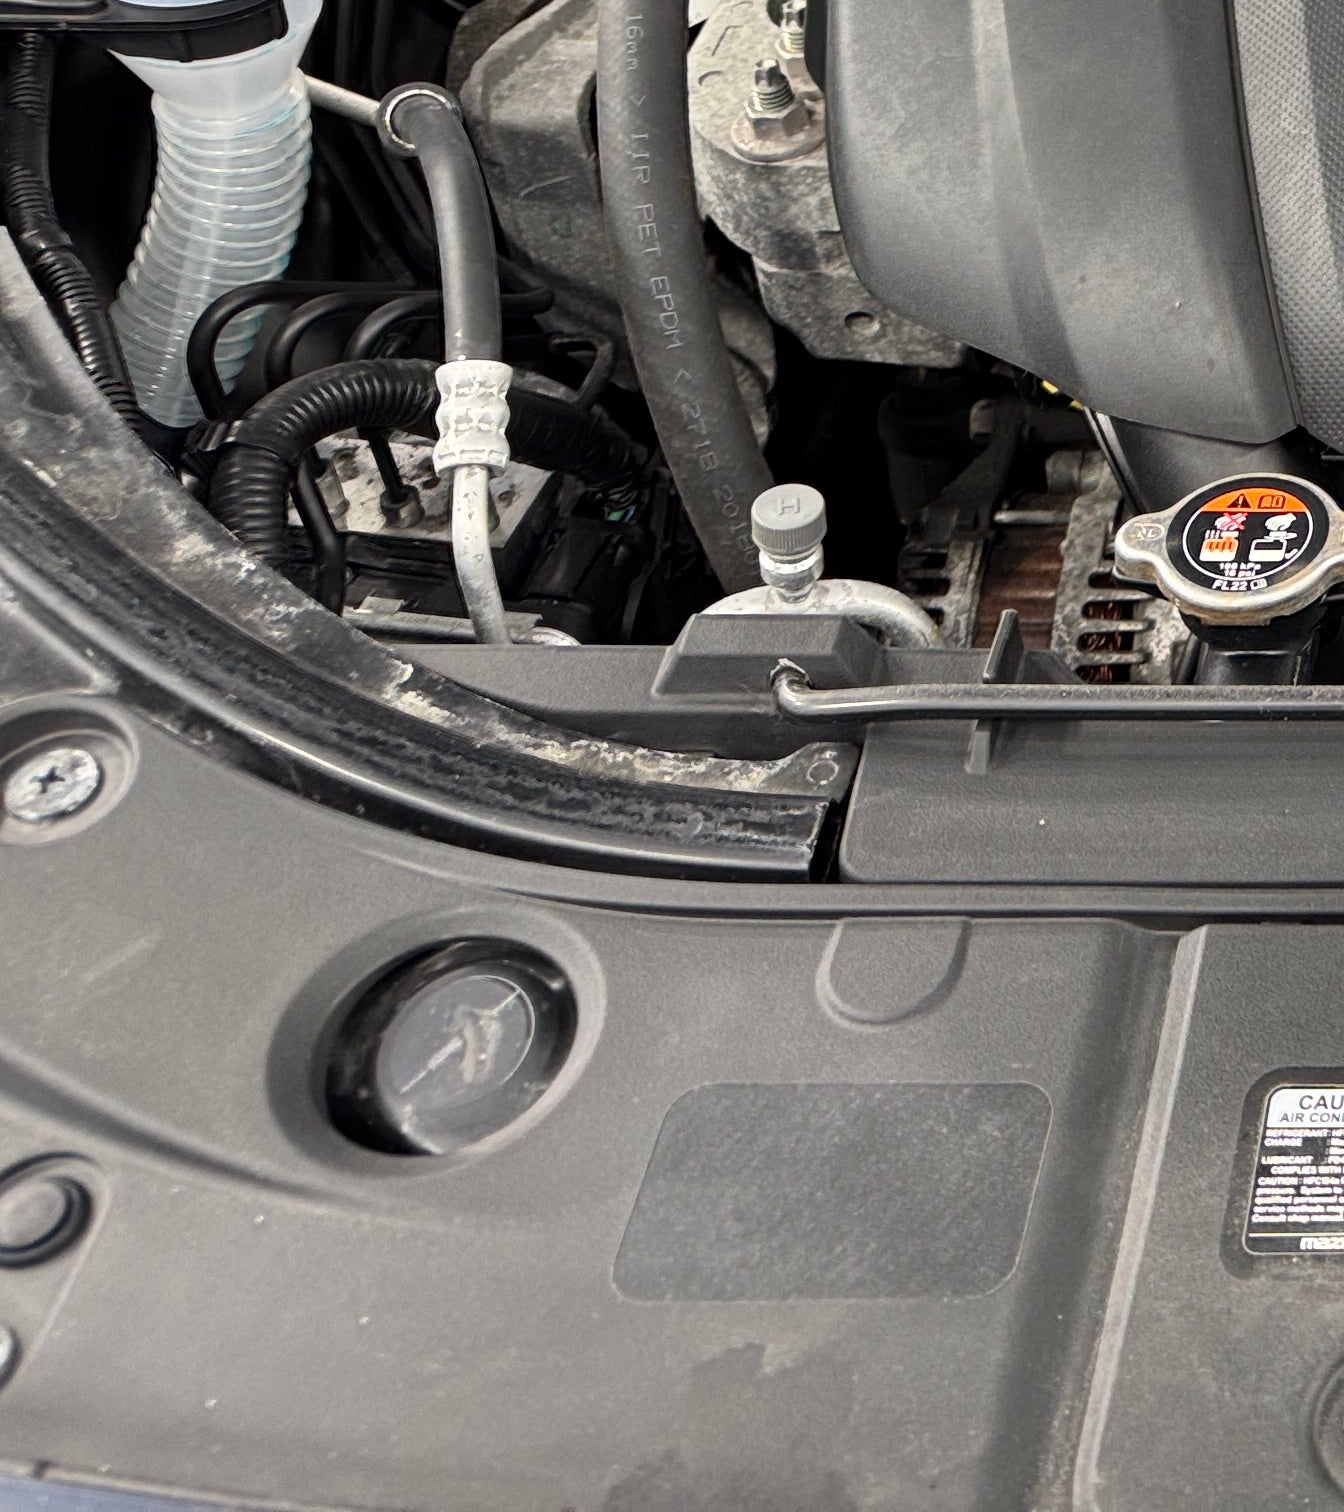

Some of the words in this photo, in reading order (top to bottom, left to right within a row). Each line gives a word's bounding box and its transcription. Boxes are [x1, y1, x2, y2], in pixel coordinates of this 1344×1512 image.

[625, 13, 645, 72] 16mm
[634, 202, 662, 258] PET
[648, 275, 685, 350] EPDM
[776, 496, 801, 516] H
[1211, 579, 1249, 591] FL22
[1279, 1112, 1307, 1123] AIR
